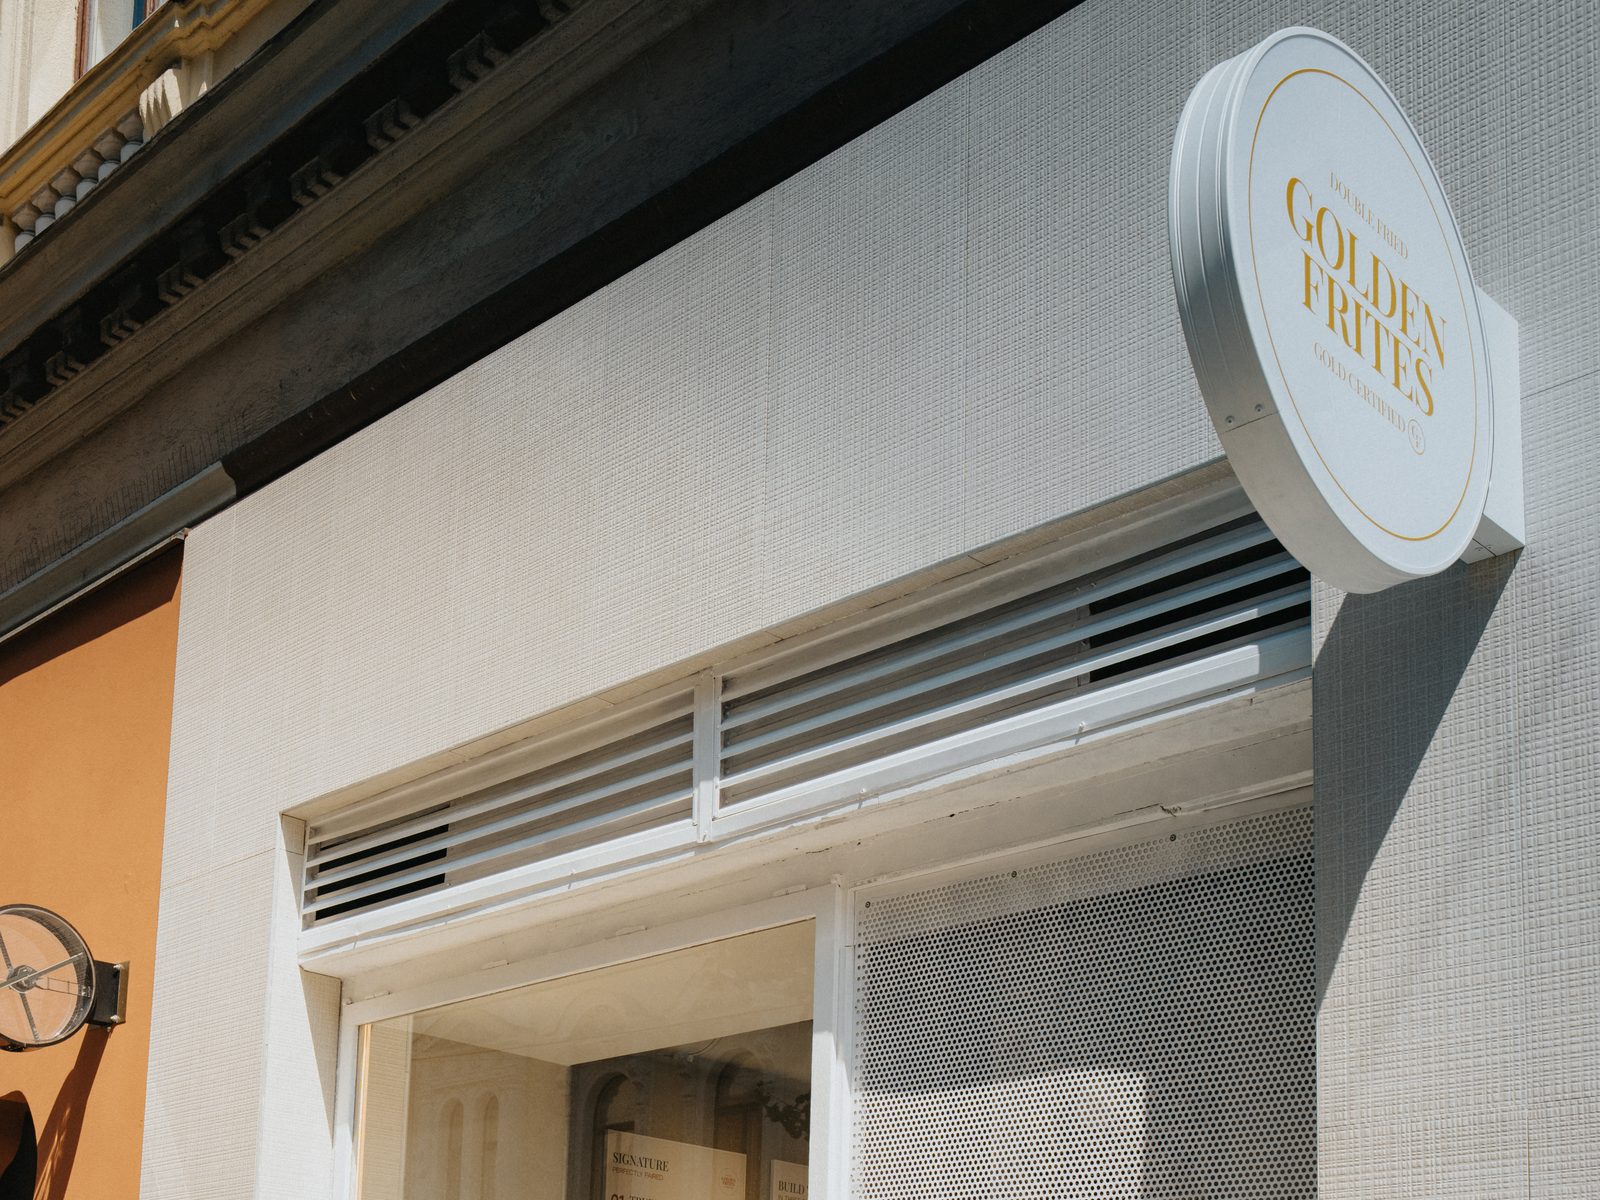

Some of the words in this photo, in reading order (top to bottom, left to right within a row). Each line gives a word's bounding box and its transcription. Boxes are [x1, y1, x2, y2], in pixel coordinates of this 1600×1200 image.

[1329, 171, 1374, 233] DOUBLE
[1377, 217, 1409, 260] FRIED
[1286, 177, 1447, 370] GOLDEN
[1301, 248, 1434, 416] FRITES
[1313, 341, 1347, 382] GOLD
[1349, 372, 1406, 433] CERTIFIED
[612, 1152, 669, 1172] SIGNATURE
[778, 1180, 805, 1195] BUILD
